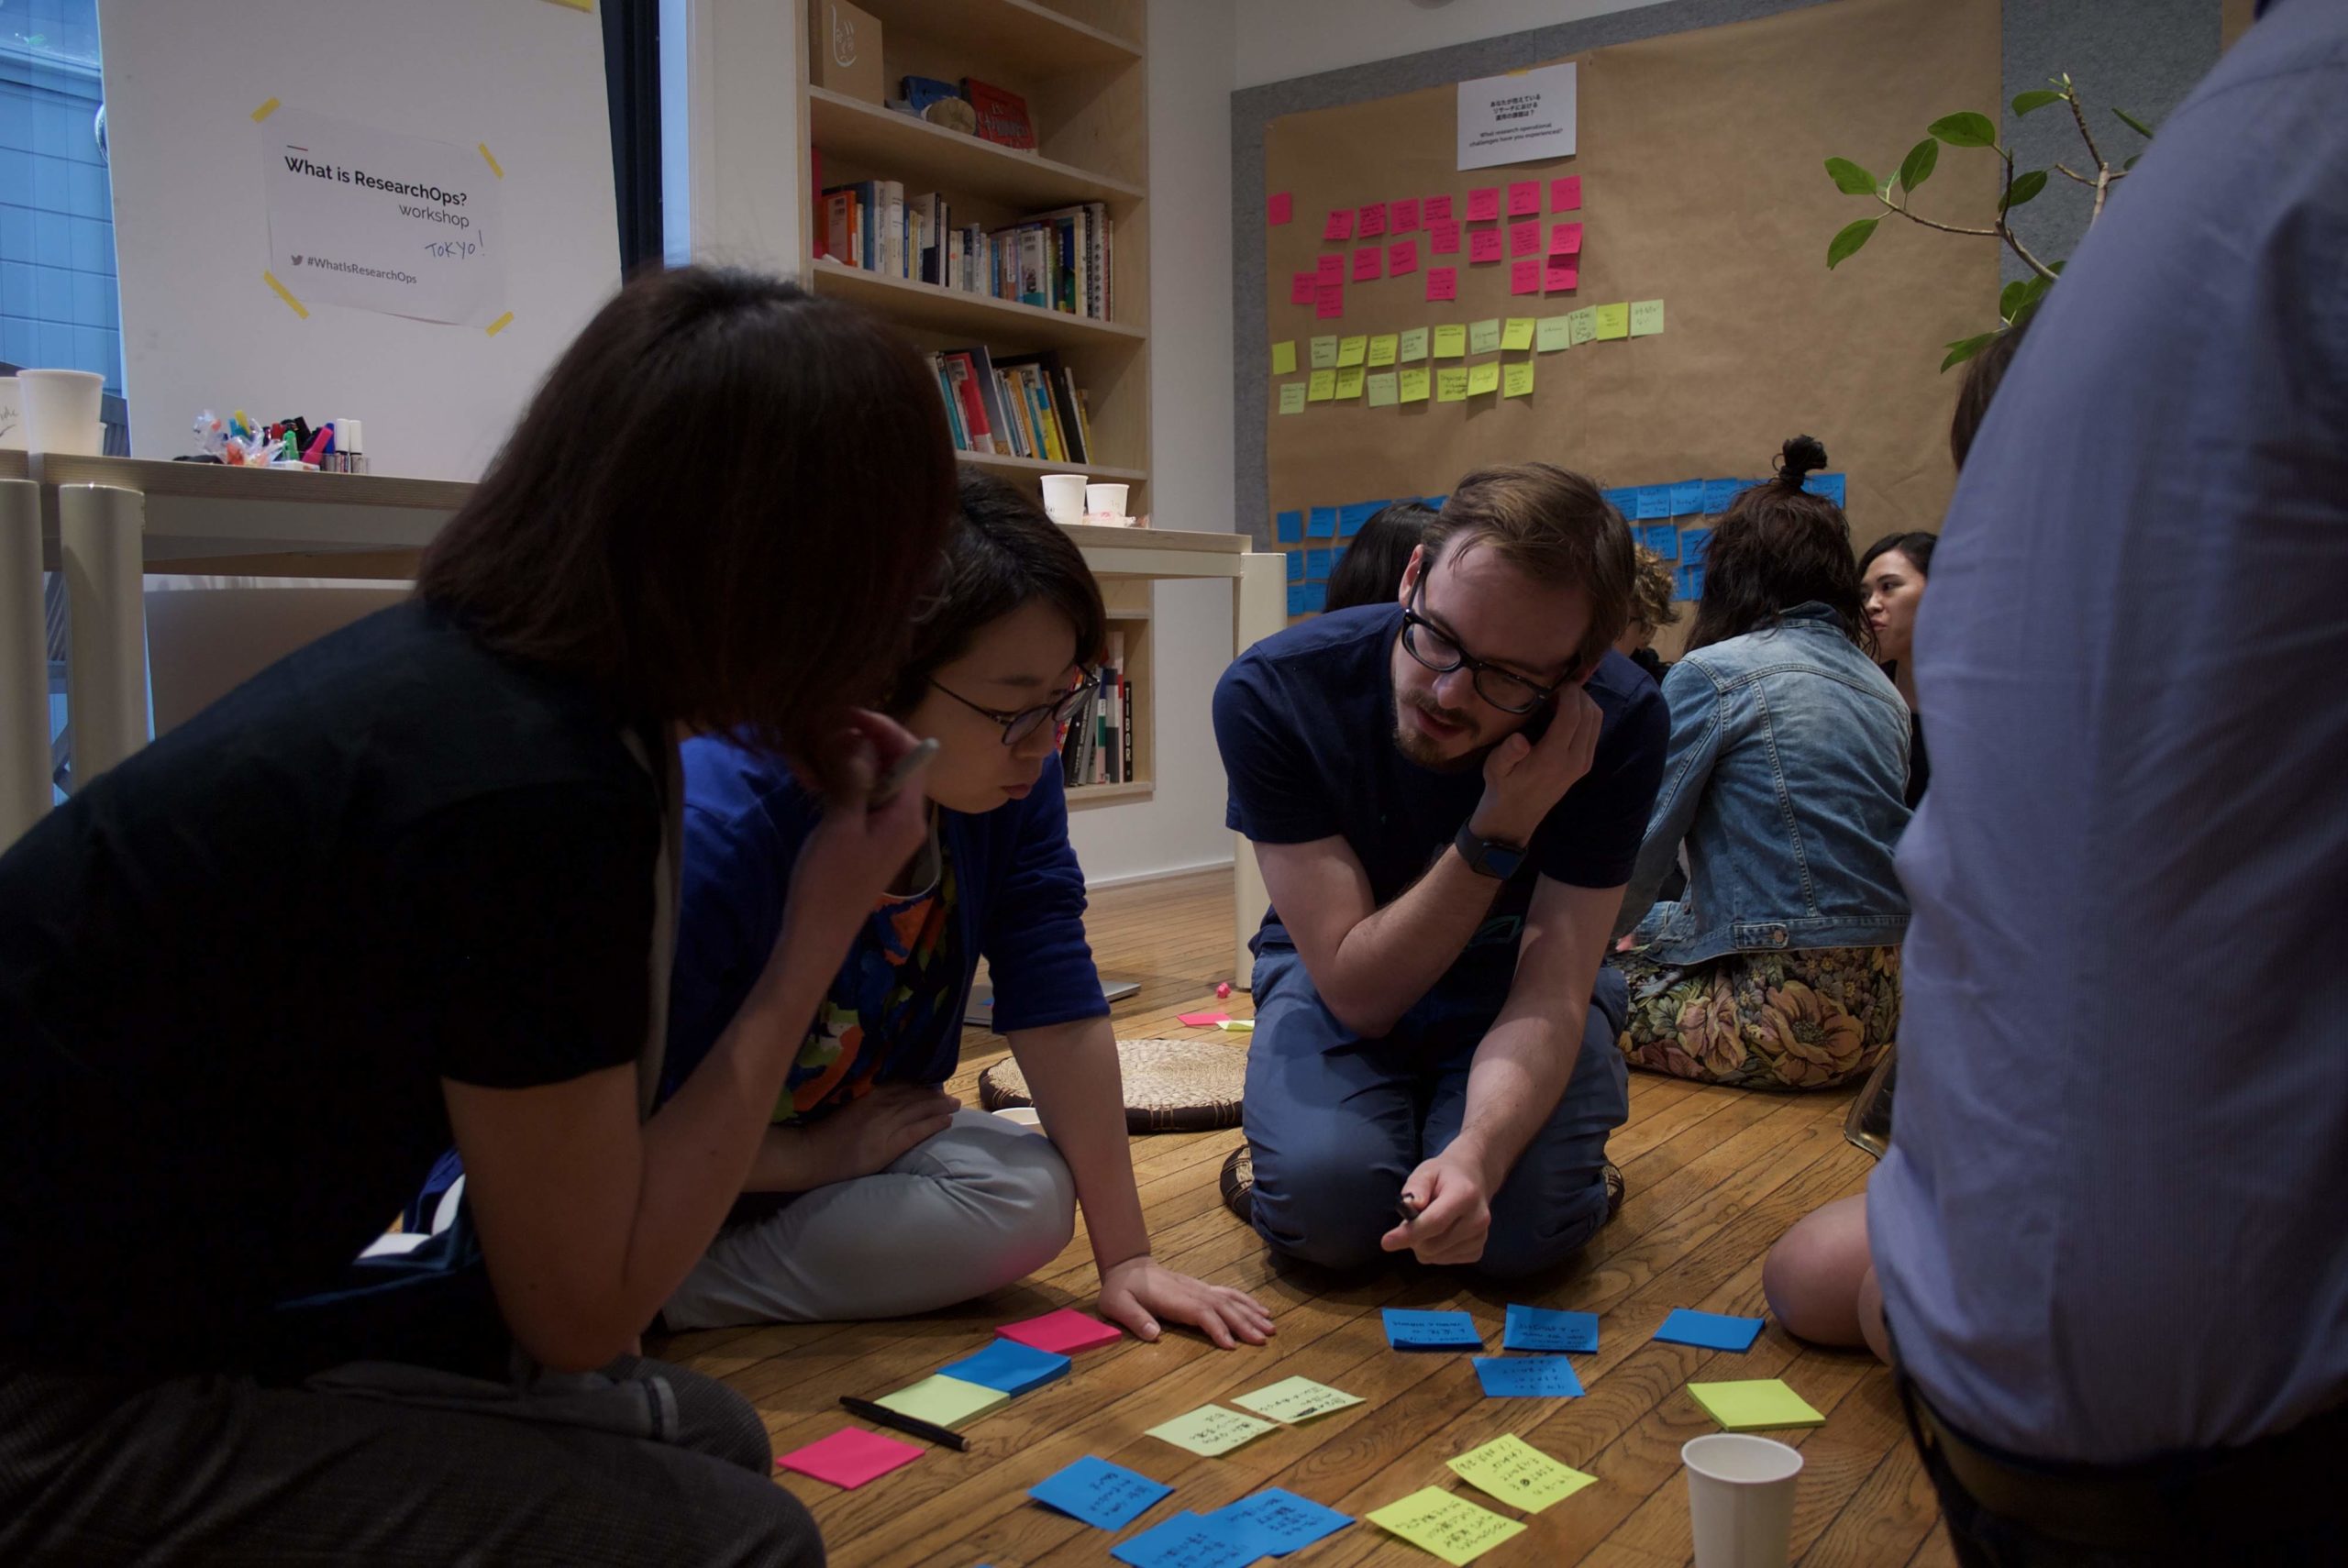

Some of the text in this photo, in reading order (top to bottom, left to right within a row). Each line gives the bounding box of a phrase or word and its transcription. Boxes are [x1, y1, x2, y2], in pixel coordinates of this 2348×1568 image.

[1468, 138, 1499, 147] challenges
[1495, 127, 1519, 136] research
[1520, 123, 1552, 132] operational
[284, 155, 468, 207] What is ResearchOps?
[398, 204, 470, 229] workshop
[425, 229, 486, 260] TOKYO!
[307, 256, 417, 284] #WhatIsResearchOps
